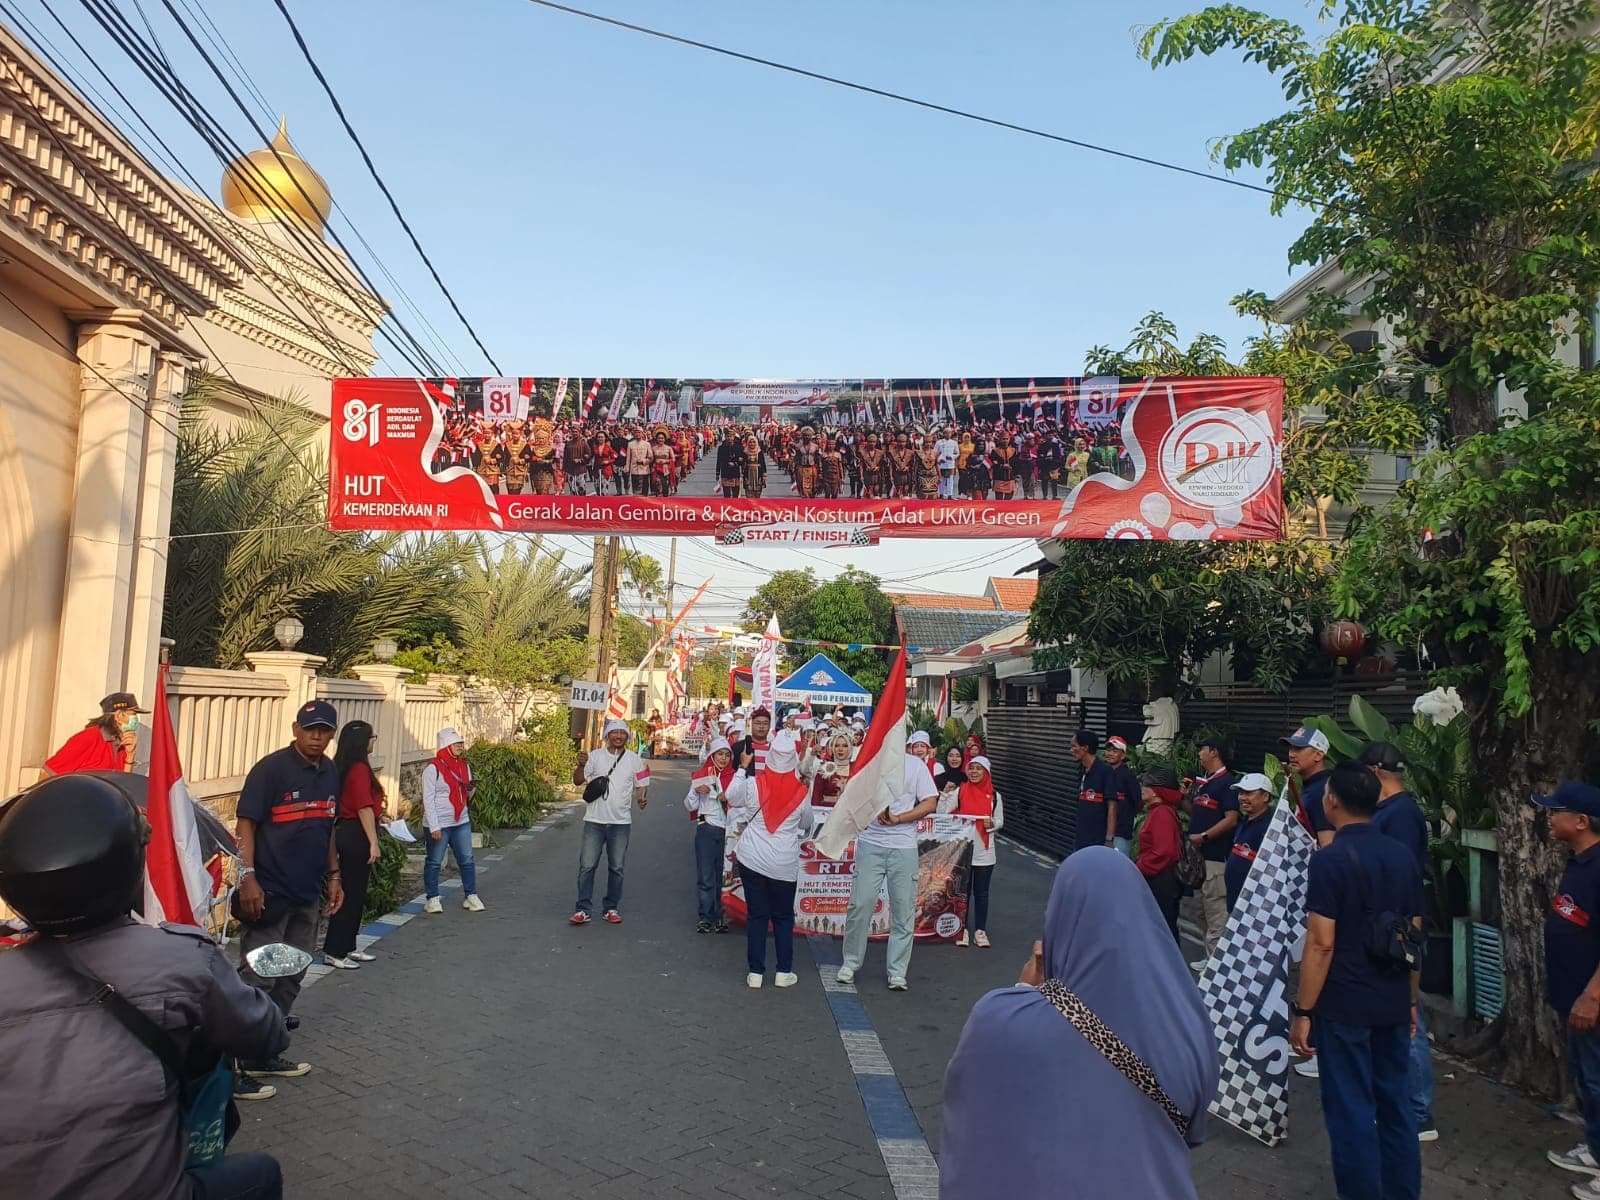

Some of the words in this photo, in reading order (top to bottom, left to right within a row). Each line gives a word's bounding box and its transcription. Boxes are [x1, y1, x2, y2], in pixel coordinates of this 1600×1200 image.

[489, 390, 512, 415] 81
[1087, 390, 1112, 414] 81
[343, 399, 383, 447] 81
[344, 475, 385, 497] HUT
[343, 502, 433, 517] KEMERDEKAAN
[436, 503, 449, 517] RI
[508, 502, 562, 520] Gerak
[566, 502, 613, 522] Jalan
[617, 503, 697, 522] Gembira
[701, 506, 715, 523] &
[720, 505, 799, 523] Karnaval
[805, 506, 875, 523] Kostum
[880, 507, 925, 524] Adat
[930, 508, 976, 525] UKM
[981, 507, 1041, 525] Green
[746, 530, 792, 542] START
[794, 529, 801, 543] /
[803, 530, 849, 542] FINISH
[572, 687, 605, 704] RT.04
[829, 694, 865, 704] PERKASA
[819, 862, 844, 874] RT
